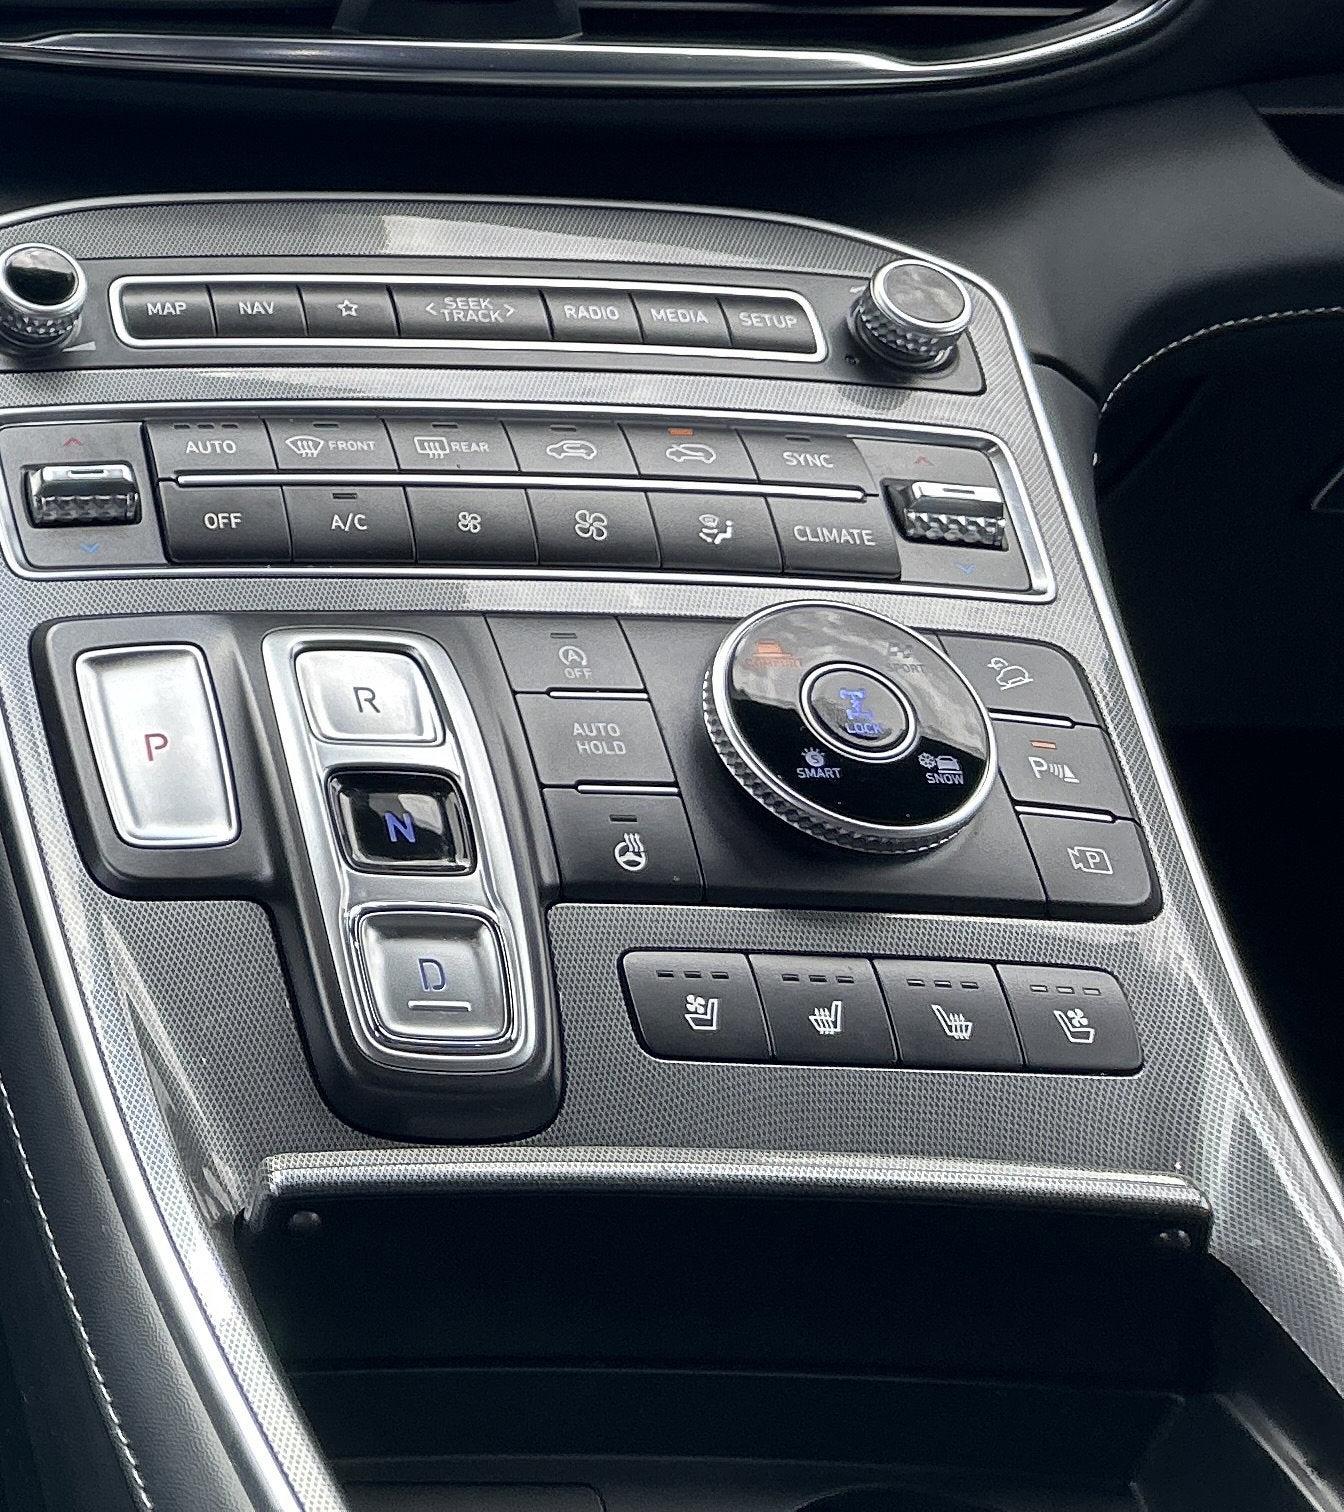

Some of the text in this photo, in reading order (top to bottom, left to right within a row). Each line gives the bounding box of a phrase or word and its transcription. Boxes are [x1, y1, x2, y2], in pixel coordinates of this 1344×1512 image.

[146, 301, 187, 316] MAP
[238, 301, 275, 316] NAV
[443, 297, 495, 312] SEEK
[440, 308, 504, 324] TRACK
[563, 305, 620, 322] RADIO
[650, 308, 710, 325] MEDIA
[739, 312, 798, 329] SETUP
[185, 440, 237, 455] AUTO
[328, 440, 376, 452] FRONT
[450, 441, 490, 454] REAR
[782, 451, 834, 469] SYNC
[204, 513, 242, 530] OFF
[331, 513, 368, 531] A/C
[794, 525, 876, 546] CLIMATE
[564, 667, 592, 679] OFF
[352, 686, 381, 714] R
[573, 722, 621, 737] AUTO
[844, 722, 885, 736] LOCK
[144, 732, 169, 762] P
[576, 740, 627, 755] HOLD
[796, 767, 841, 780] SMART
[926, 772, 964, 785] SNOW
[385, 811, 416, 843] N
[418, 958, 446, 991] D
